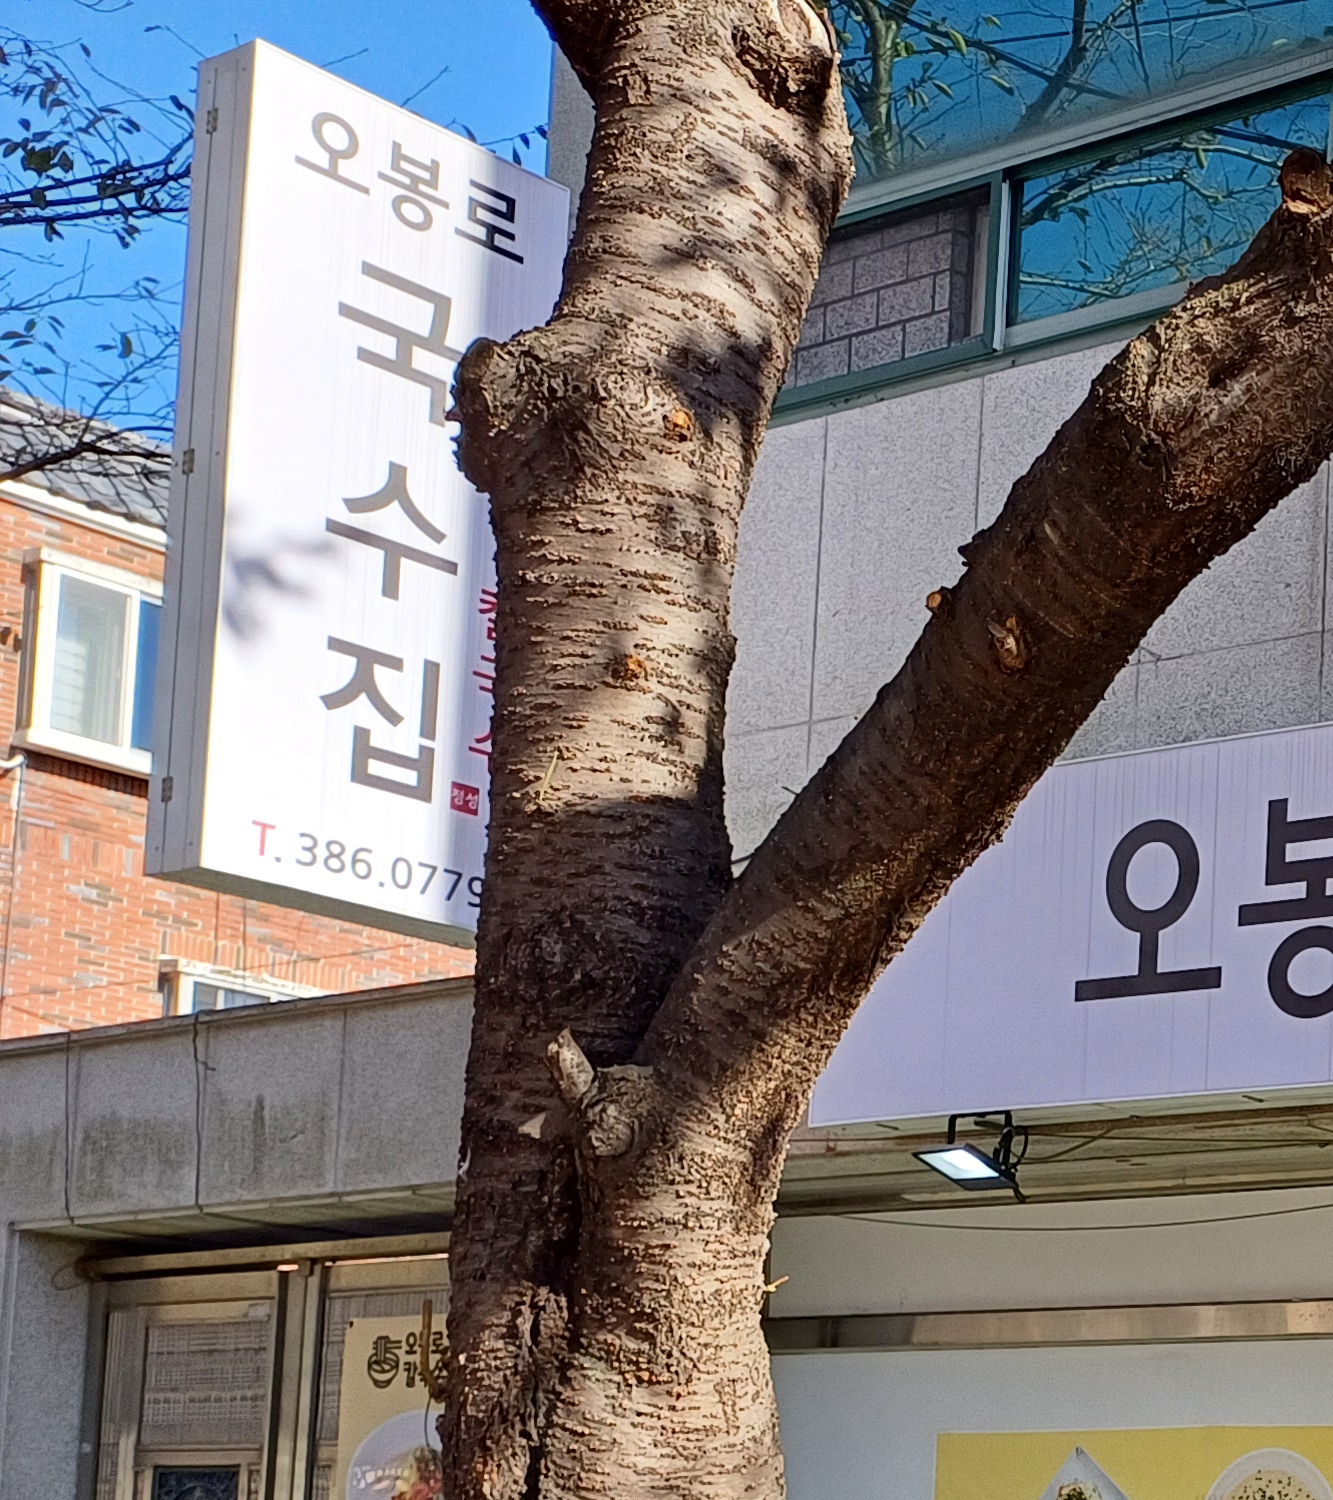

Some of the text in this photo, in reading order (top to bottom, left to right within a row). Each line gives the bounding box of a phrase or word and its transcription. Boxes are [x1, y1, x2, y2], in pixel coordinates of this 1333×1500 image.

[294, 111, 524, 265] 오봉로
[319, 260, 464, 805] 국수집
[451, 787, 479, 811] 정성
[251, 819, 484, 908] T. 386.0779
[404, 1331, 446, 1356] 오로
